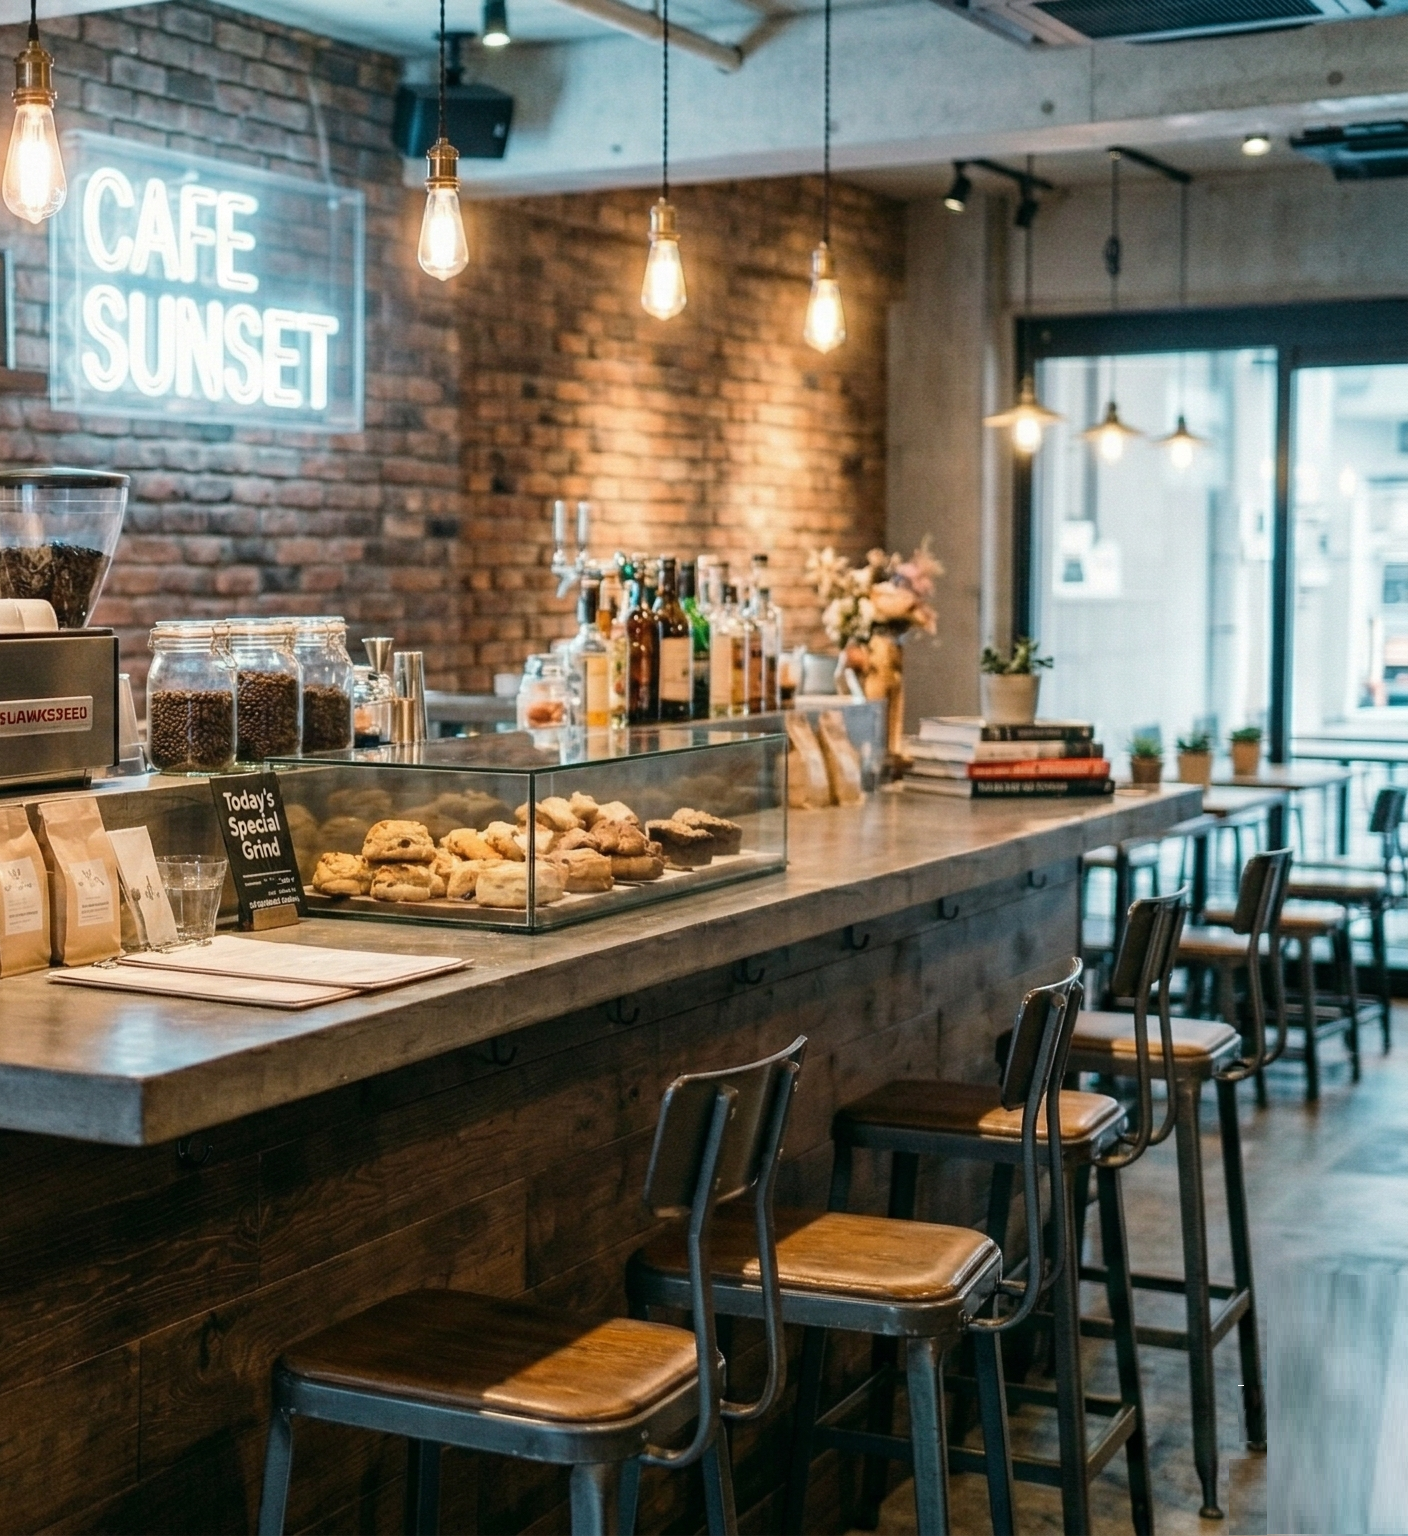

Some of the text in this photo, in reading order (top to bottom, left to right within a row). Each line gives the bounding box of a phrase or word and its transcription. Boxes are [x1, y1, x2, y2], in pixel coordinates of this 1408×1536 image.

[82, 284, 339, 410] SUNSET
[222, 787, 275, 813] Today's
[228, 811, 281, 841] Special
[241, 836, 281, 861] Grind
